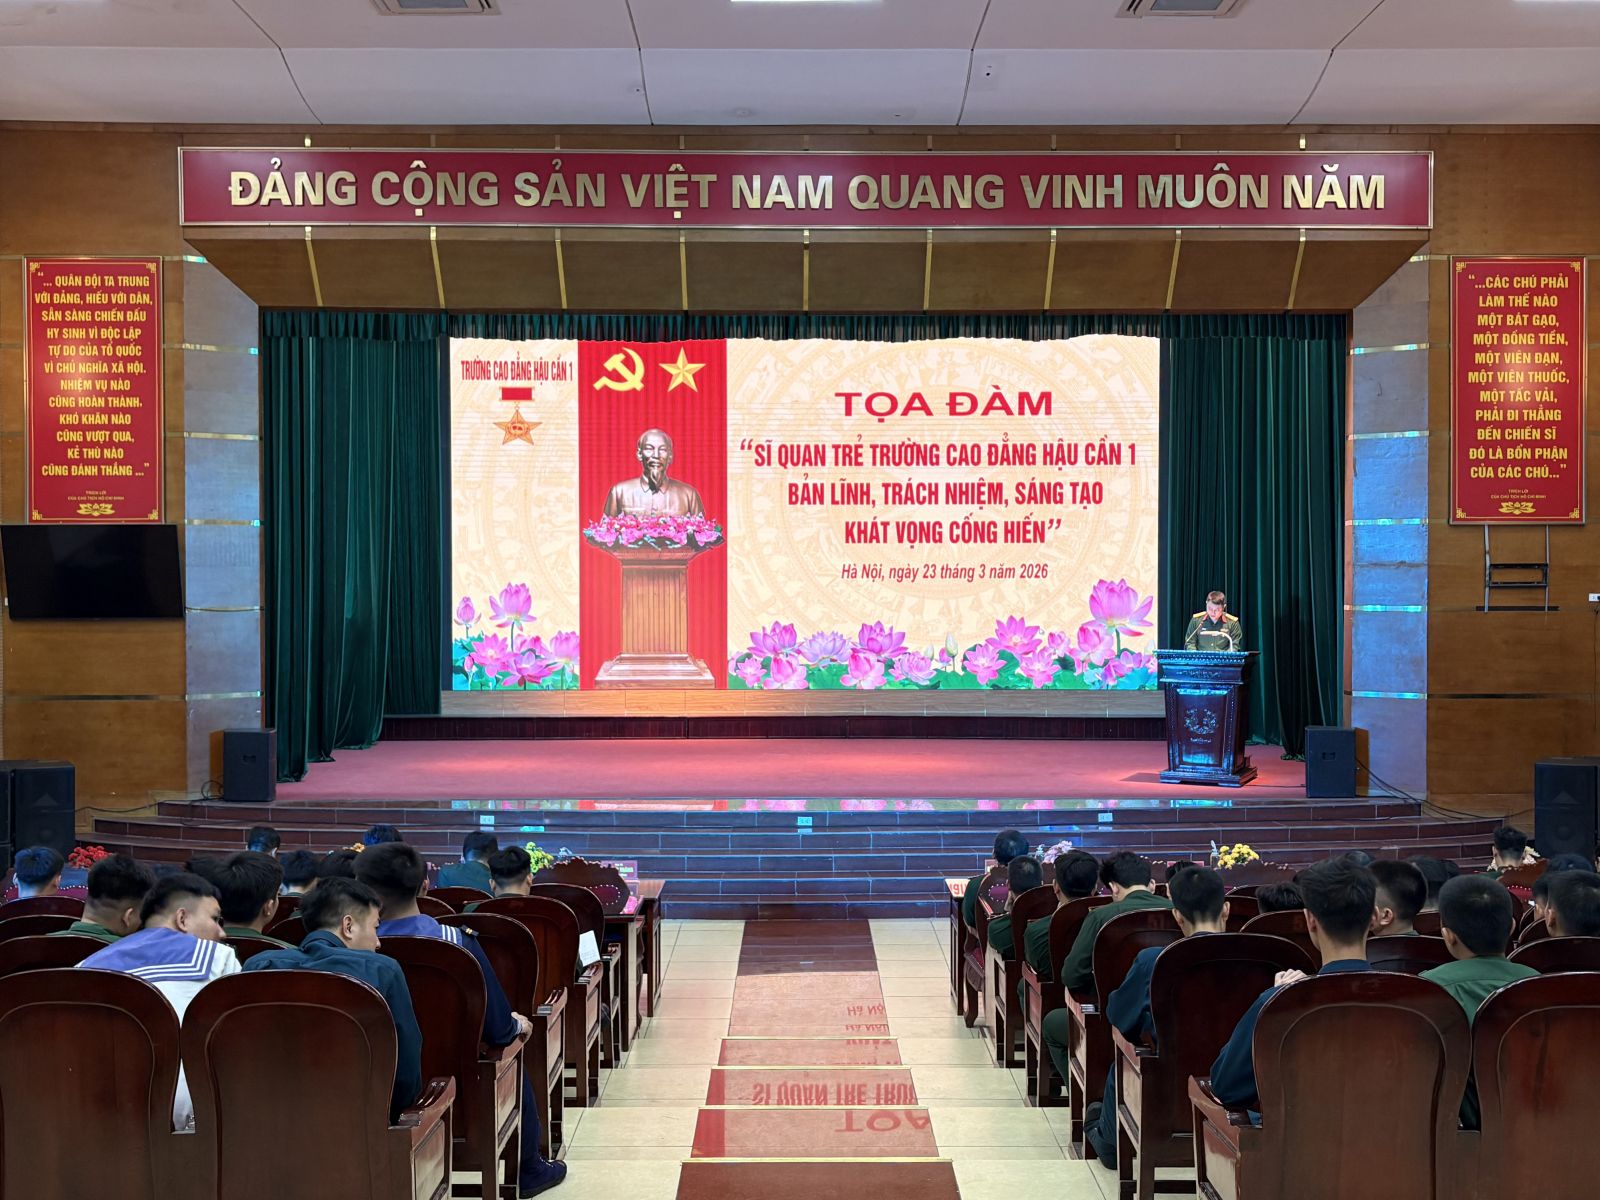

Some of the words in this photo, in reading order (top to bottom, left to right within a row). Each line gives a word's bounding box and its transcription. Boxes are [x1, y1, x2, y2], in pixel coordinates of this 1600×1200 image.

[228, 157, 355, 205] ĐẢNG
[372, 160, 498, 216] CỘNG
[515, 160, 604, 206] SẢN
[623, 164, 716, 218] VIỆT
[733, 175, 833, 208] NAM
[848, 175, 1003, 209] QUANG
[1021, 175, 1122, 208] VINH
[1138, 163, 1268, 208] MUÔN
[1284, 163, 1385, 209] NĂM
[55, 274, 82, 287] QUÂN
[85, 274, 101, 288] ĐỘI
[104, 276, 114, 286] TA
[118, 276, 149, 286] TRUNG
[1514, 275, 1536, 288] CHÚ
[1541, 273, 1568, 288] PHẢI
[35, 291, 50, 303] VỚI
[53, 290, 83, 304] ĐẢNG,
[86, 290, 108, 304] HIẾU
[111, 291, 126, 304] VỚI
[1479, 294, 1504, 307] LÀM
[1508, 292, 1529, 307] THẾ
[1534, 294, 1557, 307] NÀO
[65, 309, 91, 321] SÀNG
[95, 308, 123, 321] CHIẾN
[127, 307, 146, 321] ĐẤU
[1478, 313, 1503, 328] MỘT
[1507, 312, 1529, 325] BÁT
[1533, 315, 1559, 328] GẠO,
[47, 328, 59, 338] HY
[63, 328, 86, 339] SINH
[89, 326, 97, 339] VÌ
[101, 326, 120, 341] ĐỘC
[123, 327, 141, 341] LẬP
[1474, 331, 1498, 347] MỘT
[48, 345, 61, 358] TỰ
[63, 345, 75, 356] DO
[79, 342, 98, 356] CỦA
[101, 341, 113, 356] TỔ
[116, 342, 141, 357] QUỐC
[1475, 351, 1500, 366] MỘT
[1504, 350, 1531, 364] VIÊN
[44, 360, 53, 373] VÌ
[56, 360, 75, 373] CHỦ
[79, 361, 108, 373] NGHĨA
[112, 361, 124, 373] XÃ
[461, 355, 491, 380] TRƯỜNG
[494, 361, 508, 380] CAO
[511, 351, 531, 380] ĐẲNG
[534, 357, 548, 385] HẬU
[551, 354, 566, 381] CẦN
[569, 362, 572, 380] 1
[1469, 369, 1493, 385] MỘT
[1497, 369, 1524, 383] VIÊN
[1528, 367, 1569, 384] THUỐC,
[60, 378, 92, 392] NHIỆM
[95, 380, 107, 392] VỤ
[110, 378, 130, 390] NÀO
[49, 394, 75, 407] CŨNG
[79, 395, 104, 407] HOÀN
[1480, 388, 1505, 404] MỘT
[1509, 386, 1531, 402] TẤC
[835, 392, 933, 423] TỌA
[946, 385, 1052, 416] ĐÀM
[60, 412, 79, 424] KHÓ
[82, 412, 108, 424] KHĂN
[111, 412, 131, 424] NÀO
[1476, 406, 1503, 421] PHẢI
[1507, 410, 1518, 421] ĐI
[1523, 404, 1561, 420] THẲNG
[57, 429, 83, 441] CŨNG
[86, 430, 110, 443] VƯỢT
[113, 431, 134, 442] QUA,
[1477, 425, 1501, 440] ĐẾN
[1505, 425, 1540, 440] CHIẾN
[1545, 427, 1555, 439] SĨ
[68, 445, 80, 458] KẺ
[83, 446, 101, 459] THÙ
[104, 446, 123, 459] NÀO
[741, 439, 771, 466] “SĨ
[778, 444, 826, 469] QUAN
[832, 434, 863, 466] TRẺ
[870, 438, 939, 466] TRƯỜNG
[947, 444, 981, 466] CAO
[987, 433, 1036, 466] ĐẲNG
[1043, 438, 1078, 470] HẬU
[1085, 435, 1121, 465] CẦN
[1129, 443, 1135, 465] 1
[1469, 446, 1485, 459] ĐÓ
[1489, 446, 1503, 459] LÀ
[1507, 444, 1531, 459] BỔN
[1535, 446, 1567, 461] PHẬN
[42, 464, 68, 475] CŨNG
[71, 464, 97, 475] ĐÁNH
[101, 462, 132, 476] THẮNG
[1471, 463, 1494, 478] CỦA
[1498, 465, 1521, 478] CÁC
[789, 473, 824, 505] BẢN
[831, 478, 875, 508] LĨNH,
[882, 478, 938, 505] TRÁCH
[946, 478, 1008, 509] NHIỆM,
[1015, 477, 1063, 504] SÁNG
[1070, 482, 1103, 509] TẠO
[845, 516, 890, 543] KHÁT
[896, 521, 942, 548] VỌNG
[950, 513, 997, 543] CỐNG
[1004, 512, 1061, 543] HIẾN”
[842, 564, 857, 579] Hà
[862, 564, 884, 582] Nội,
[889, 564, 919, 583] ngày
[923, 564, 936, 578] 23
[941, 564, 975, 582] tháng
[979, 564, 985, 578] 3
[990, 564, 1015, 578] năm
[1020, 564, 1048, 578] 2026
